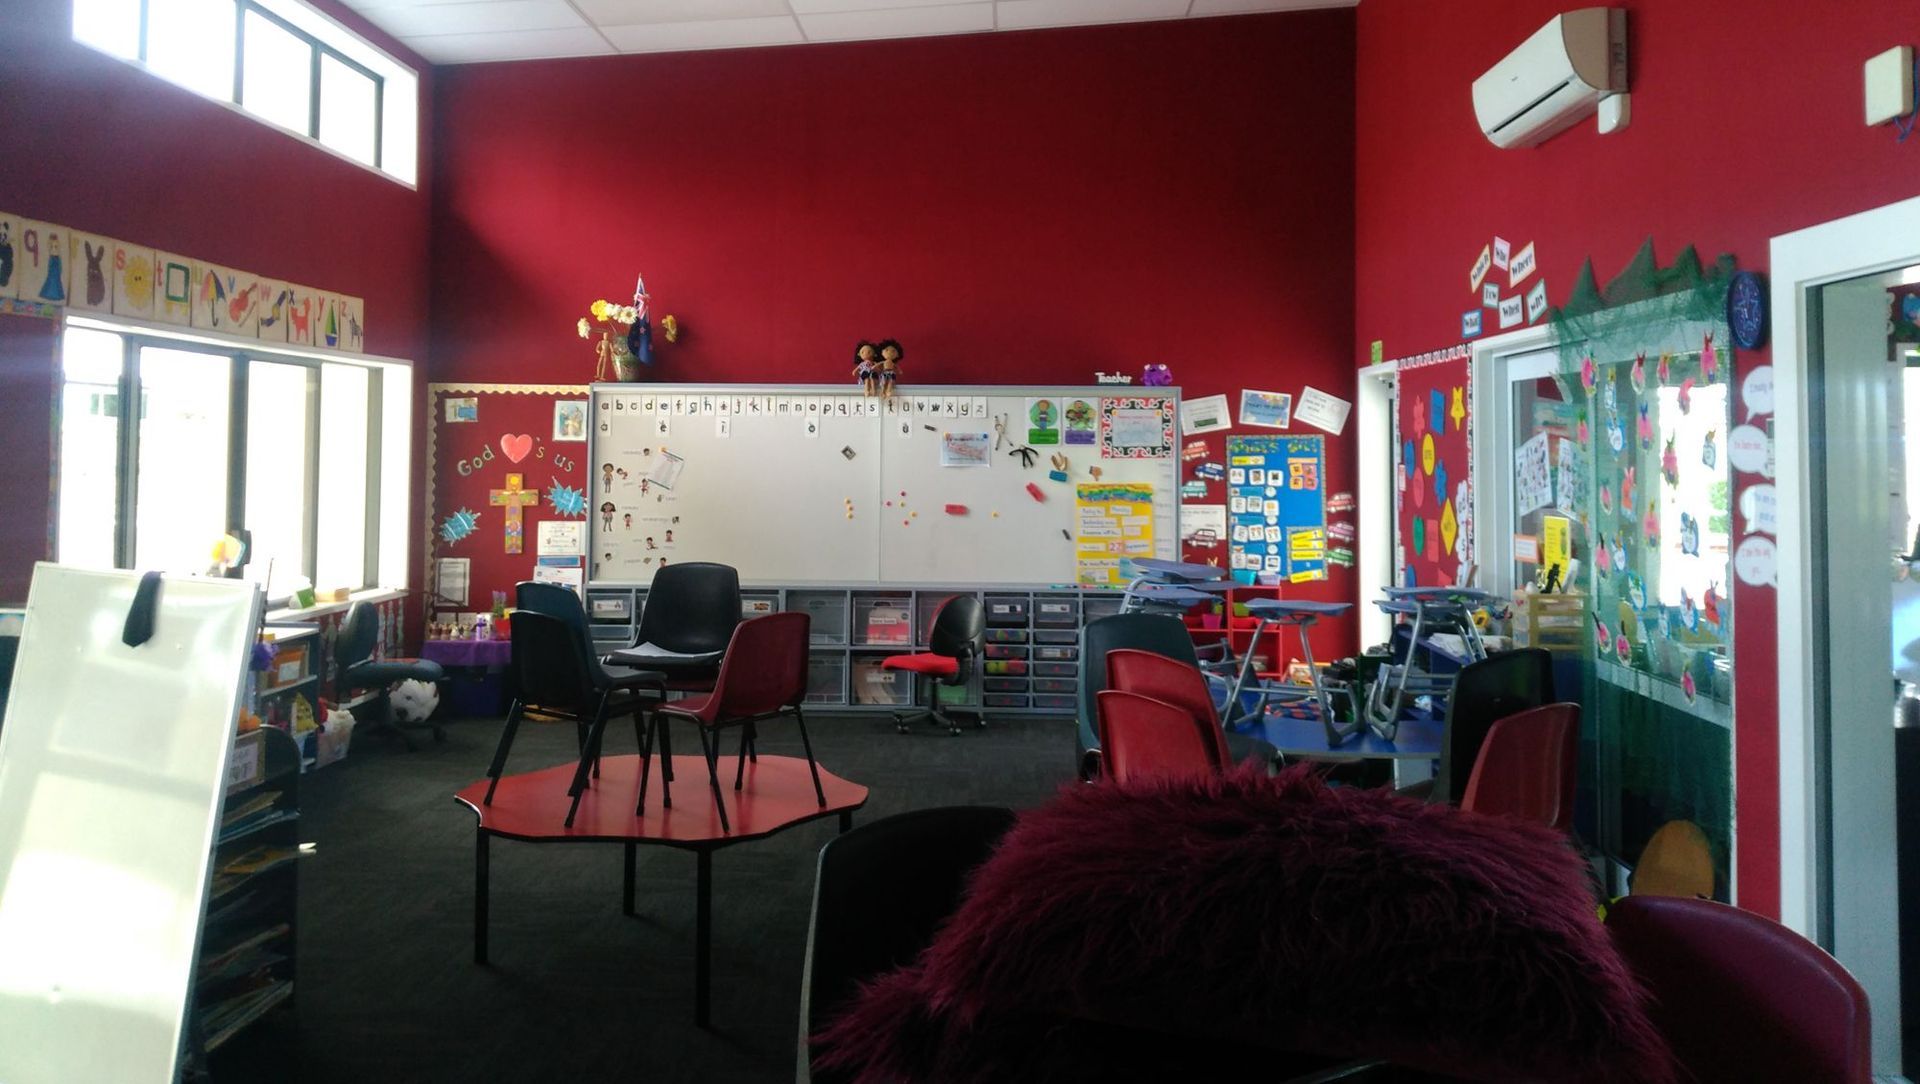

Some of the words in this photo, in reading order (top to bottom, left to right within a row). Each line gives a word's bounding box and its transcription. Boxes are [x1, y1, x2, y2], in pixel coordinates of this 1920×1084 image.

[24, 229, 38, 267] q
[116, 249, 126, 270] s
[1095, 371, 1132, 384] Teacher
[457, 444, 495, 476] God
[554, 453, 575, 472] us
